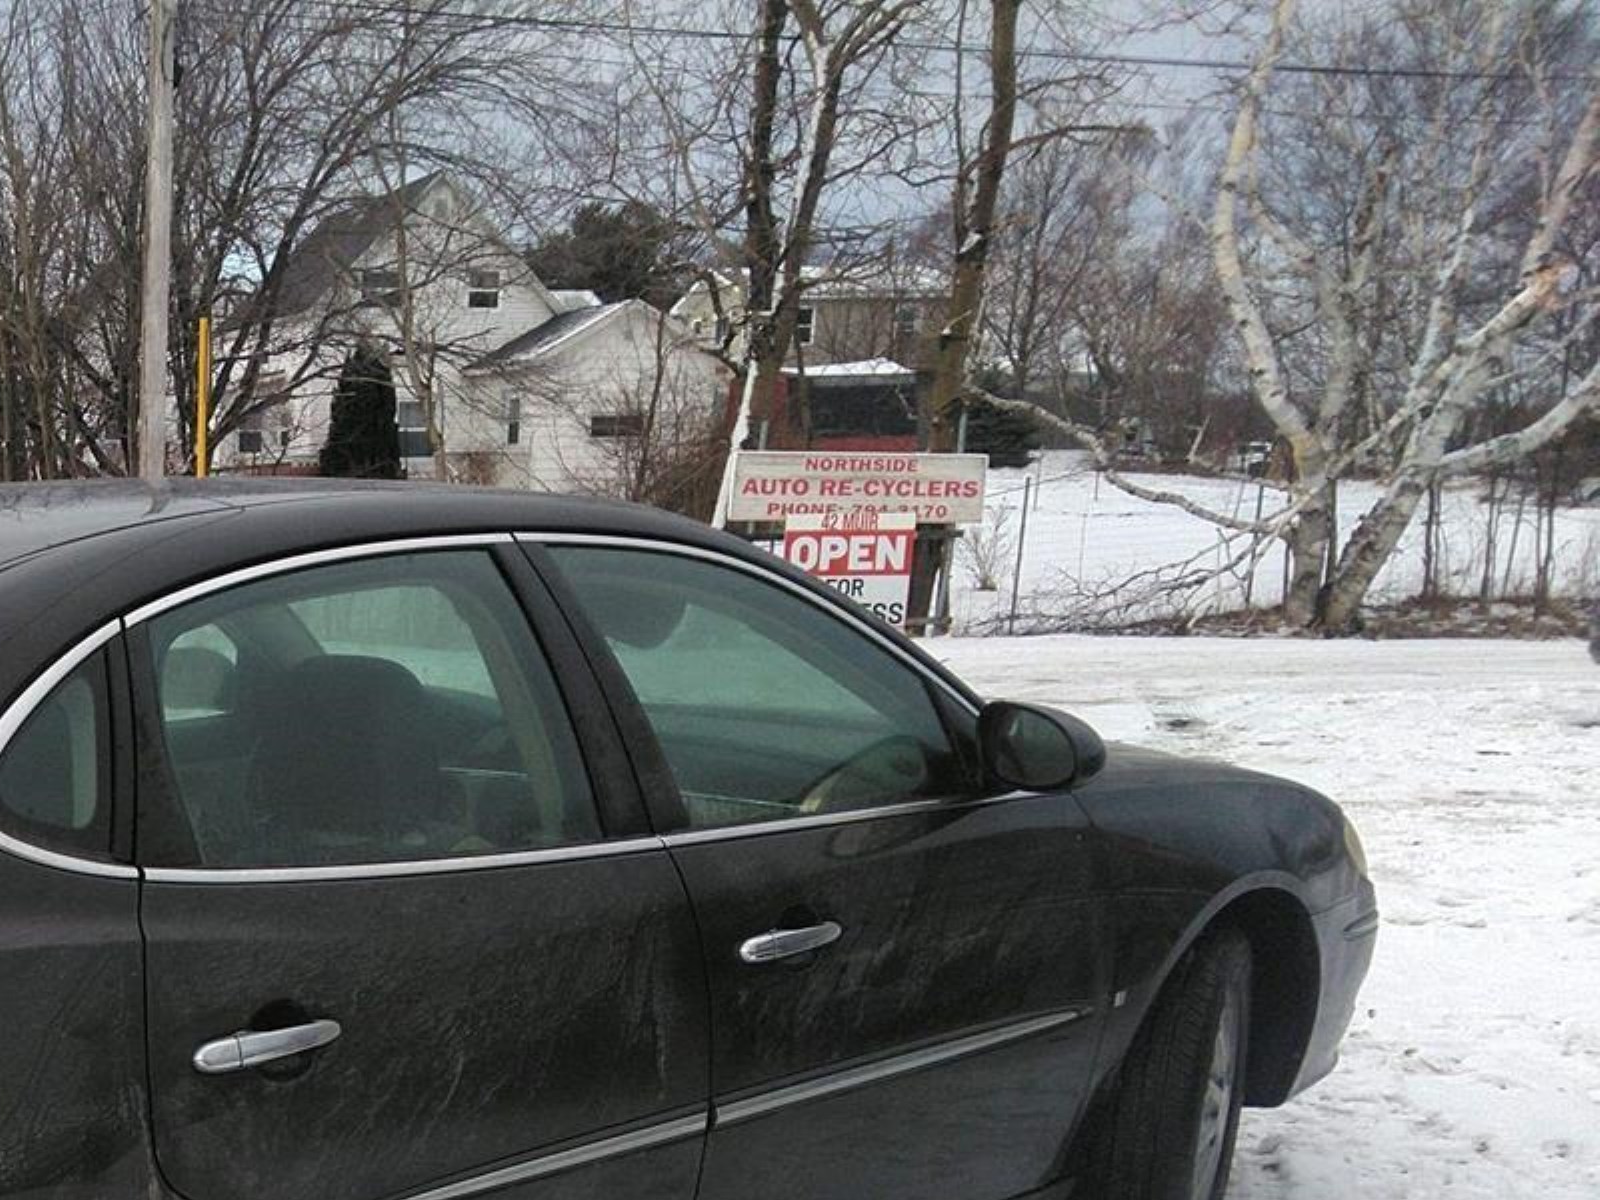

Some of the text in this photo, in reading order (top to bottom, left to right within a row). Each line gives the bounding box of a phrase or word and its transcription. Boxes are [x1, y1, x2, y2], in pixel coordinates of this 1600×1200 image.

[805, 458, 919, 472] NORTHSIDE
[742, 479, 979, 498] AUTO RE-CYCLERS
[789, 535, 908, 571] OPEN
